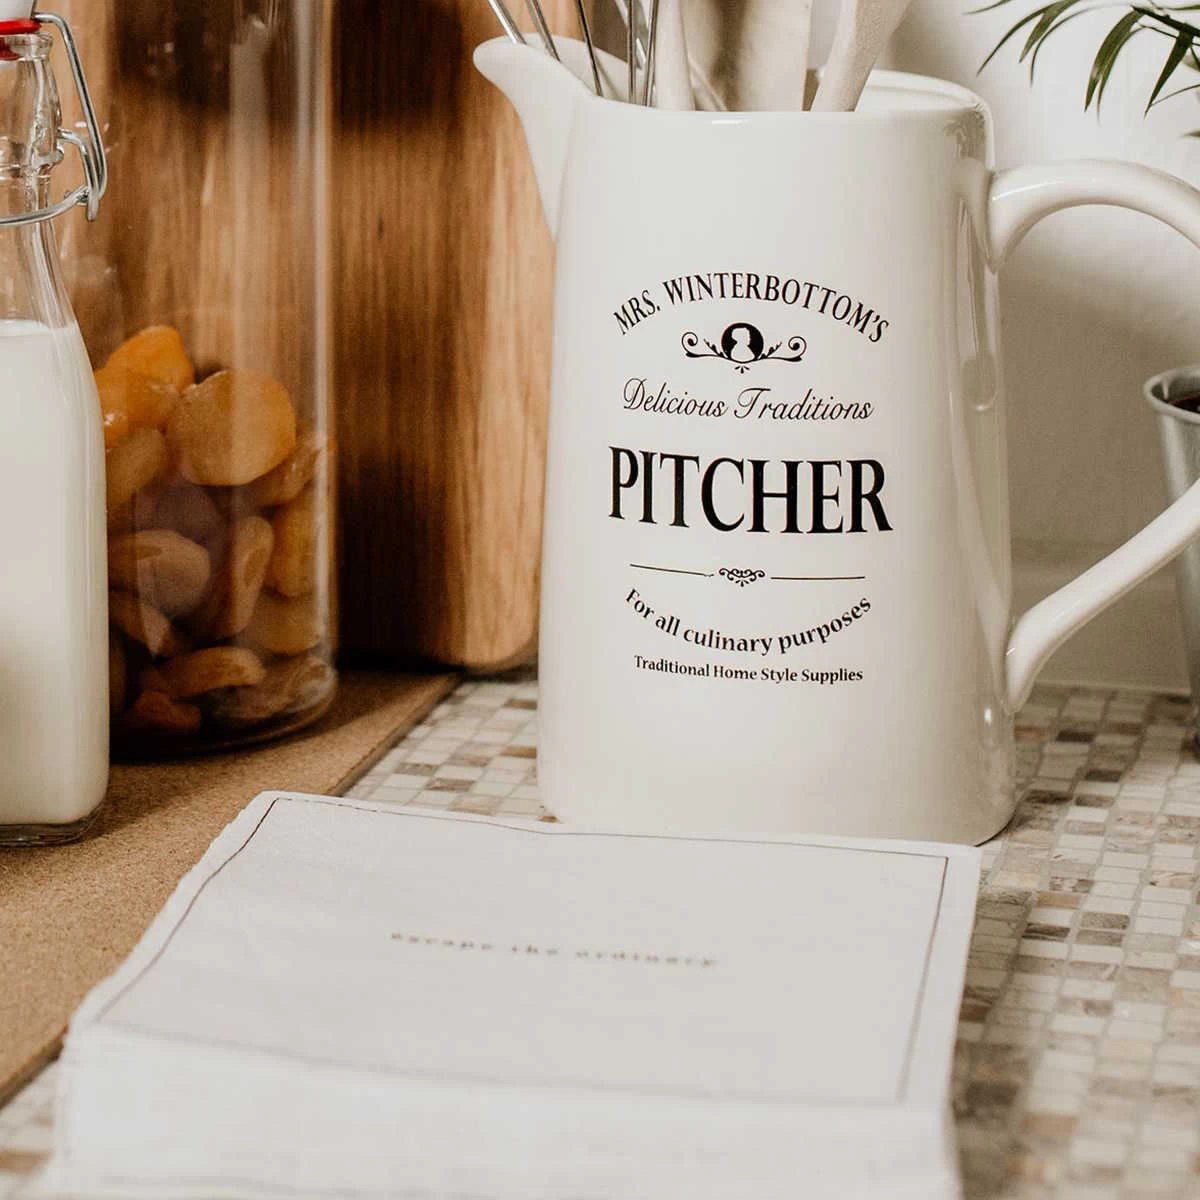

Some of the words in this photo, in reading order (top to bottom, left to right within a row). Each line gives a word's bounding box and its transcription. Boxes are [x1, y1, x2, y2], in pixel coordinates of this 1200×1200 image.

[612, 289, 662, 336] MRS.
[661, 272, 890, 343] WINTERBOTTOM'S
[623, 377, 729, 418] Delicious
[733, 387, 875, 421] Traditions
[608, 445, 894, 535] PITCHER
[625, 587, 655, 619] For
[654, 615, 681, 637] all
[683, 628, 773, 657] culinary
[777, 597, 872, 655] purposes
[633, 654, 711, 678] Traditional
[713, 663, 758, 681] Home
[760, 667, 799, 685] Style
[801, 667, 864, 686] Supplies
